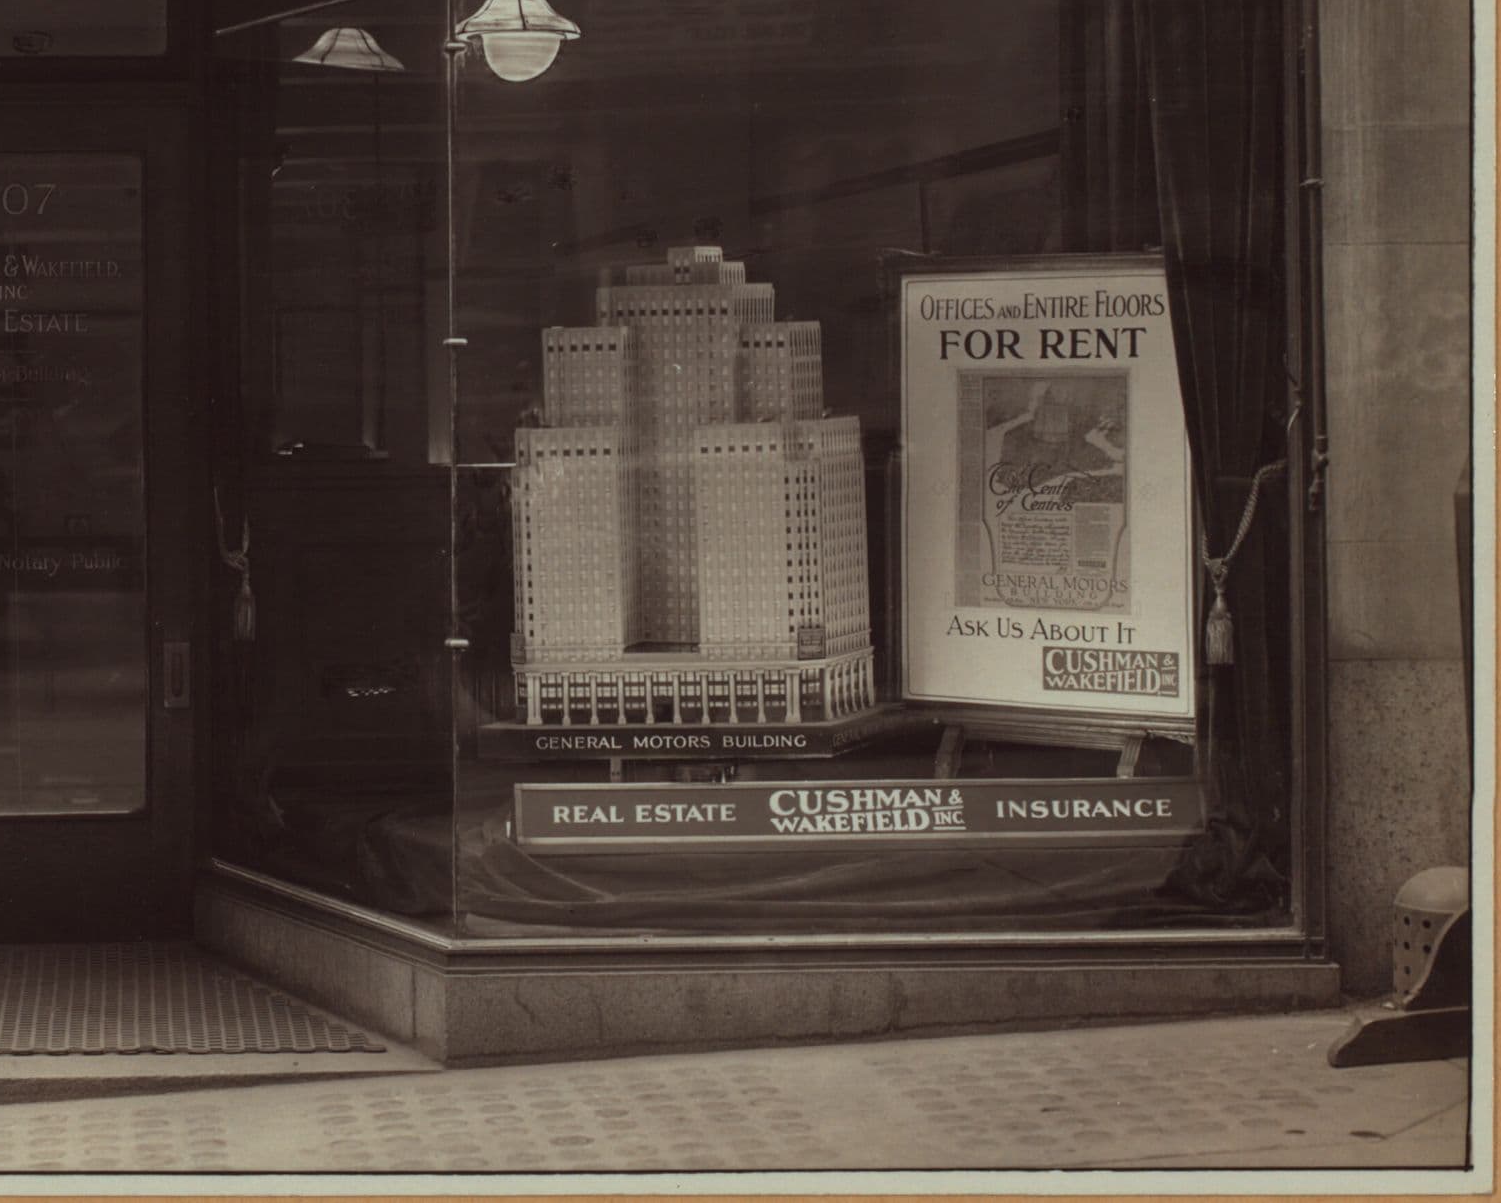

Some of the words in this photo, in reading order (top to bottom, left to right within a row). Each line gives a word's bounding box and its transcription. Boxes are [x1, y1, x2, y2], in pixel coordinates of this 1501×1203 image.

[4, 254, 20, 278] &
[920, 294, 995, 321] OFFICES
[997, 305, 1021, 319] AND
[1023, 293, 1090, 319] ENTIRE
[1095, 290, 1166, 318] FLOORS
[4, 309, 90, 333] ESTATE
[940, 329, 1024, 360] FOR
[1039, 327, 1147, 360] RENT
[996, 494, 1019, 517] of
[1021, 492, 1075, 511] Centres
[982, 572, 1059, 590] GENERAL
[1063, 576, 1129, 593] MOTORS
[946, 615, 990, 638] ASK
[997, 616, 1024, 639] US
[1031, 617, 1110, 643] ABOUT
[1117, 621, 1136, 645] IT
[1045, 648, 1159, 675] CUSHMAN
[1163, 653, 1175, 666] &
[1045, 668, 1161, 694] WAKEFIELD
[536, 735, 622, 750] GENERAL
[633, 734, 711, 750] MOTORS
[723, 734, 808, 749] BUILDING
[552, 805, 624, 824] REAL
[635, 802, 737, 823] ESTATE
[769, 789, 943, 816] CUSHMAN
[948, 788, 964, 805] &
[996, 798, 1173, 819] INSURANCE
[770, 808, 930, 833] WAKEFIELD
